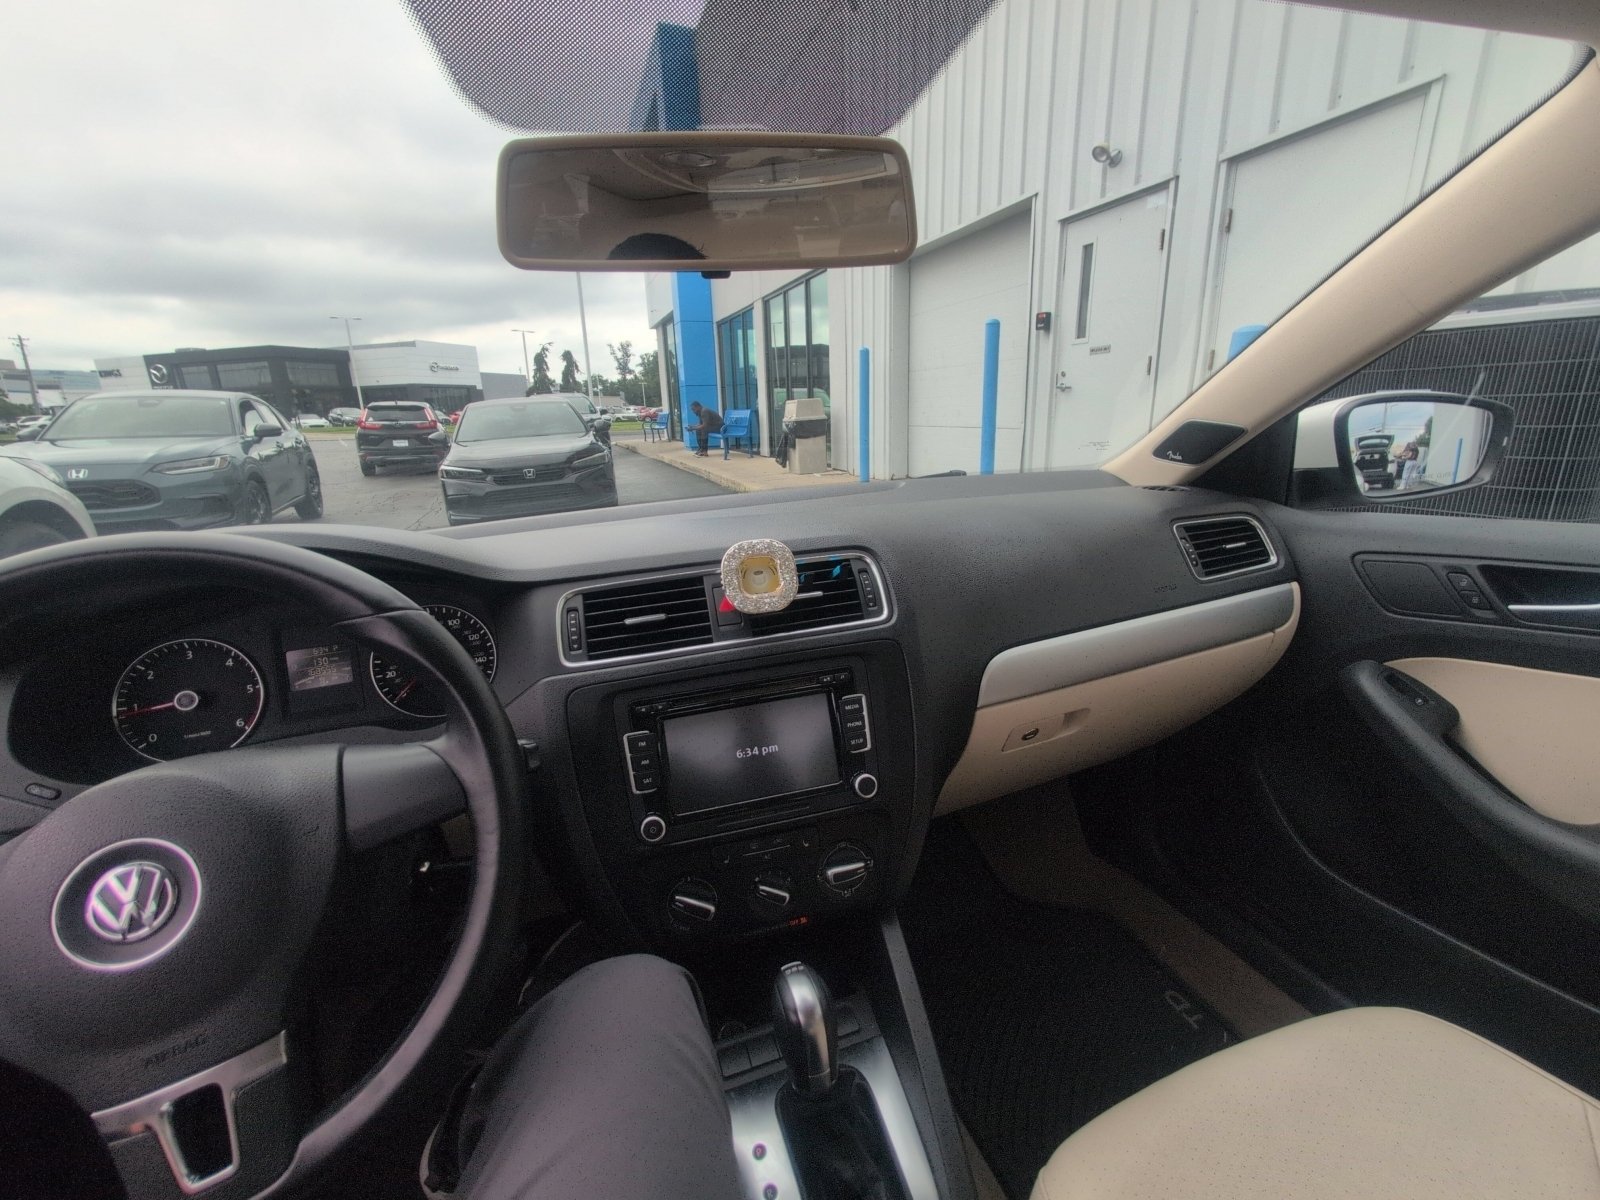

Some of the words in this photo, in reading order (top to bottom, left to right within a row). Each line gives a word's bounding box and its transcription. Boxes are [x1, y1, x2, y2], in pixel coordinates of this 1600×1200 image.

[447, 618, 460, 626] 100
[185, 650, 194, 660] 3
[225, 657, 234, 667] 4
[147, 670, 155, 680] 2
[385, 670, 397, 679] 20
[246, 684, 254, 694] 5
[132, 703, 138, 712] 1
[235, 718, 245, 728] 6
[148, 733, 158, 743] 0
[736, 745, 759, 759] 6:34
[761, 744, 779, 756] pm
